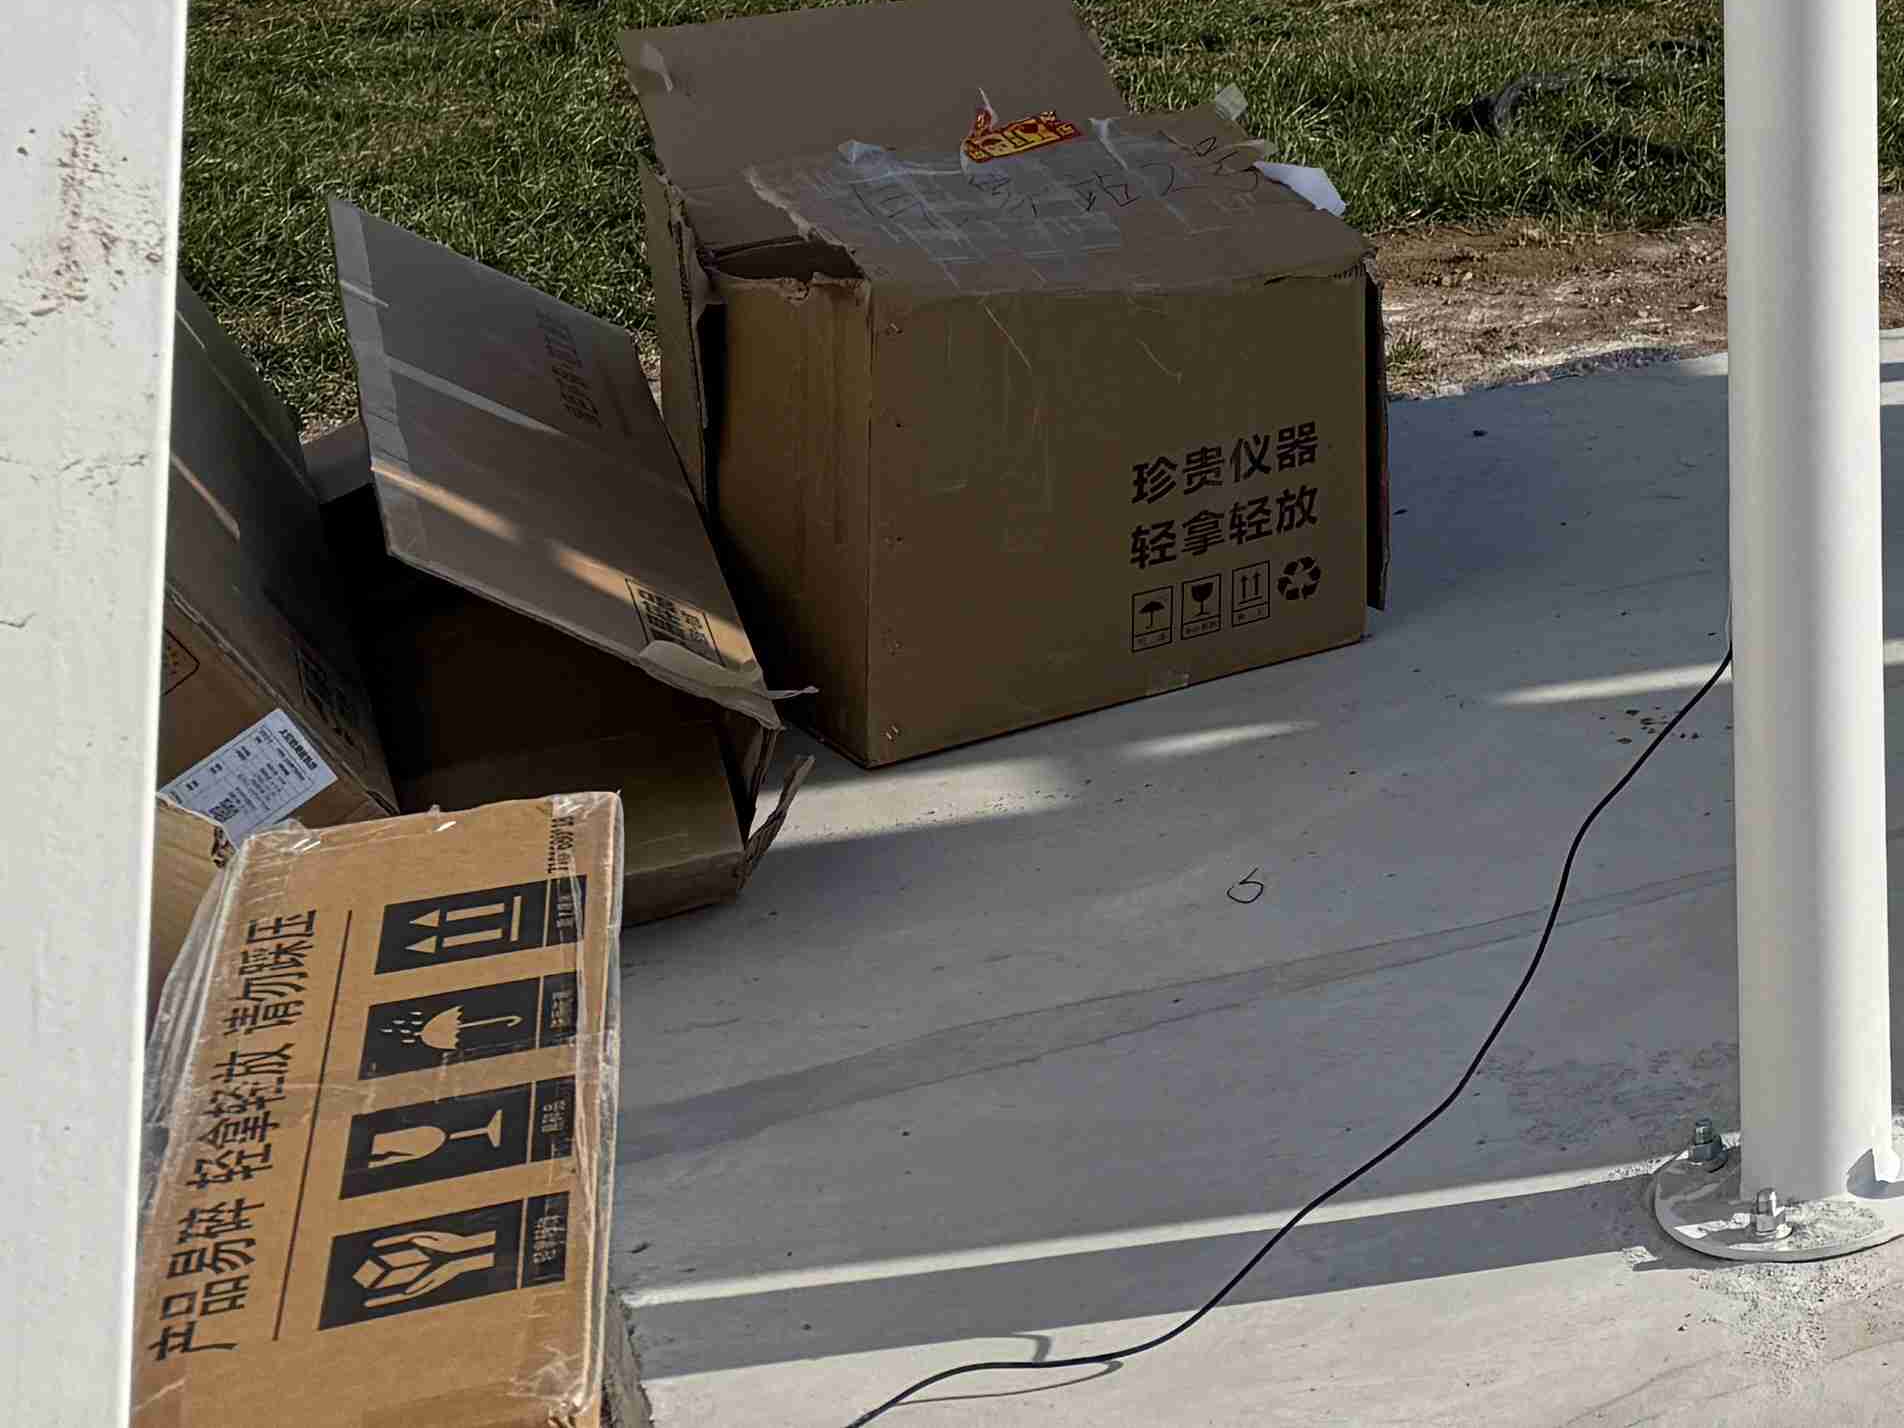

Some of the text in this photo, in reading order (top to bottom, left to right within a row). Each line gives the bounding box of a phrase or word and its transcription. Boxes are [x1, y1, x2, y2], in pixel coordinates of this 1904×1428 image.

[1129, 484, 1319, 569] 轻拿轻放
[1132, 421, 1319, 505] 珍贵仪器
[222, 908, 318, 1041] 请勿踩压
[188, 1042, 290, 1190] 轻拿轻放
[148, 1196, 265, 1363] 产品易碎
